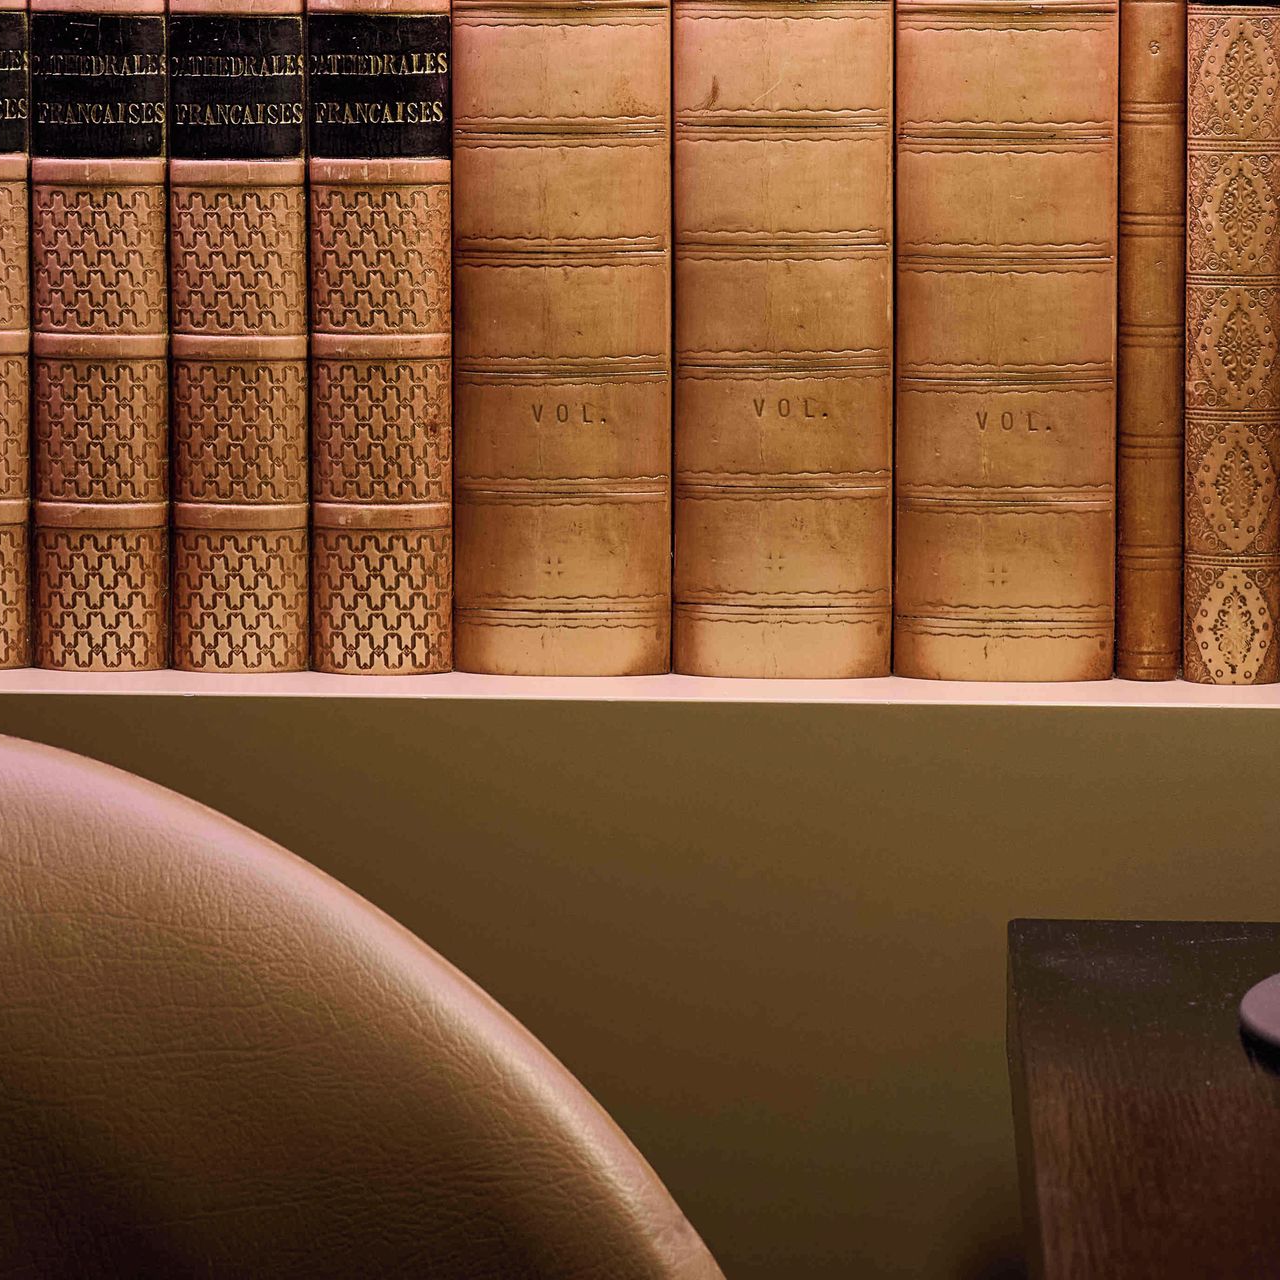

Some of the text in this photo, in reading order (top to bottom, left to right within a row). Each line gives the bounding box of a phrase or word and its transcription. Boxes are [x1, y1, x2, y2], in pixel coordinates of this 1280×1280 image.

[531, 402, 608, 426] VOL.
[753, 397, 830, 420] VOL.
[976, 410, 1053, 434] VOL.
